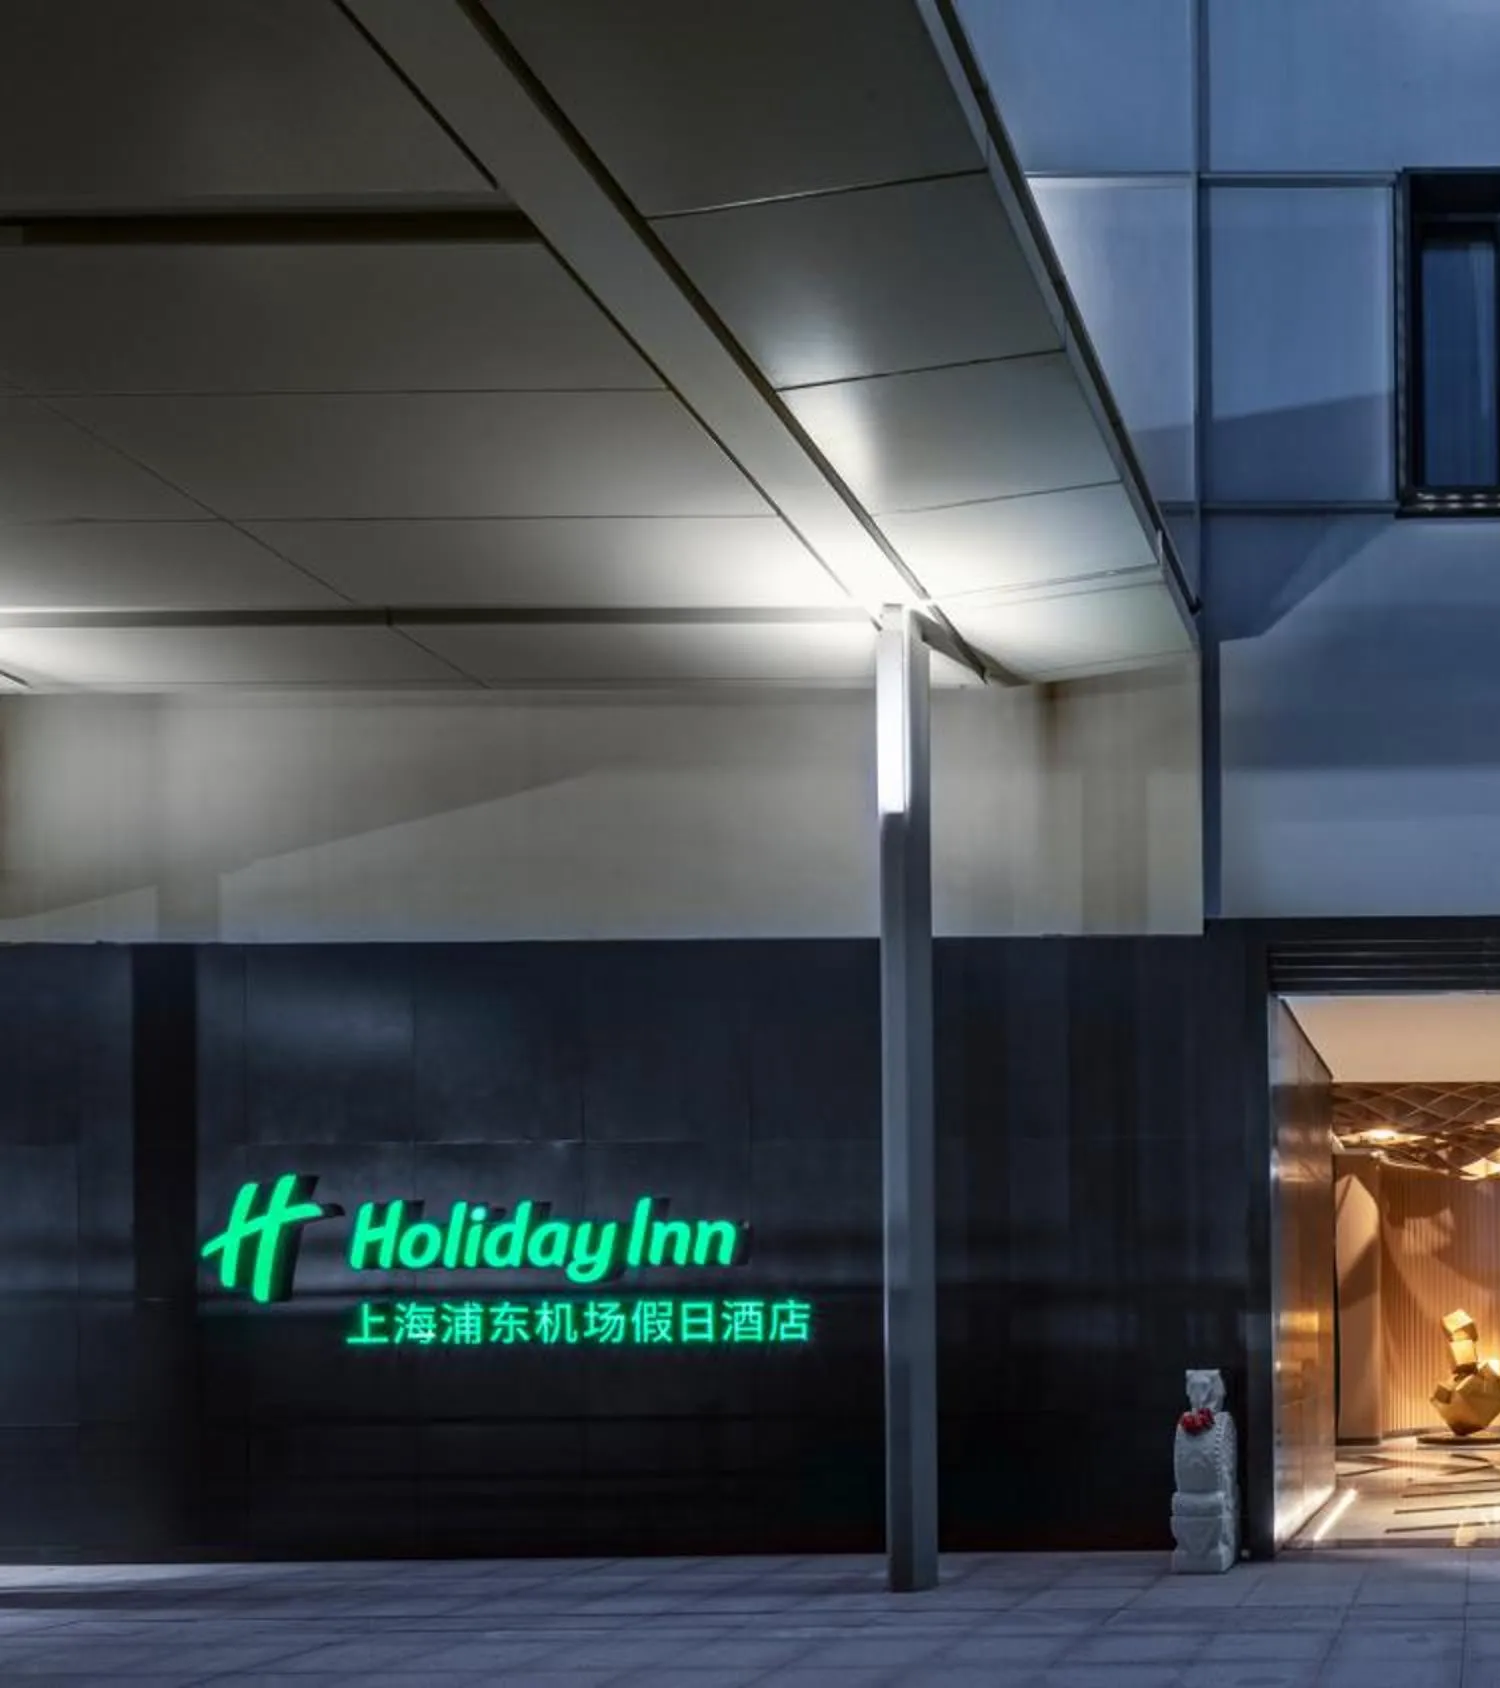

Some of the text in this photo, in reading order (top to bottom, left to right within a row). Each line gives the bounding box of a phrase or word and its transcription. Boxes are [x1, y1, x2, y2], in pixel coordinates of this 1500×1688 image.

[349, 1197, 737, 1284] Holiday Inn
[346, 1299, 812, 1345] 上海浦东机场假日酒店
